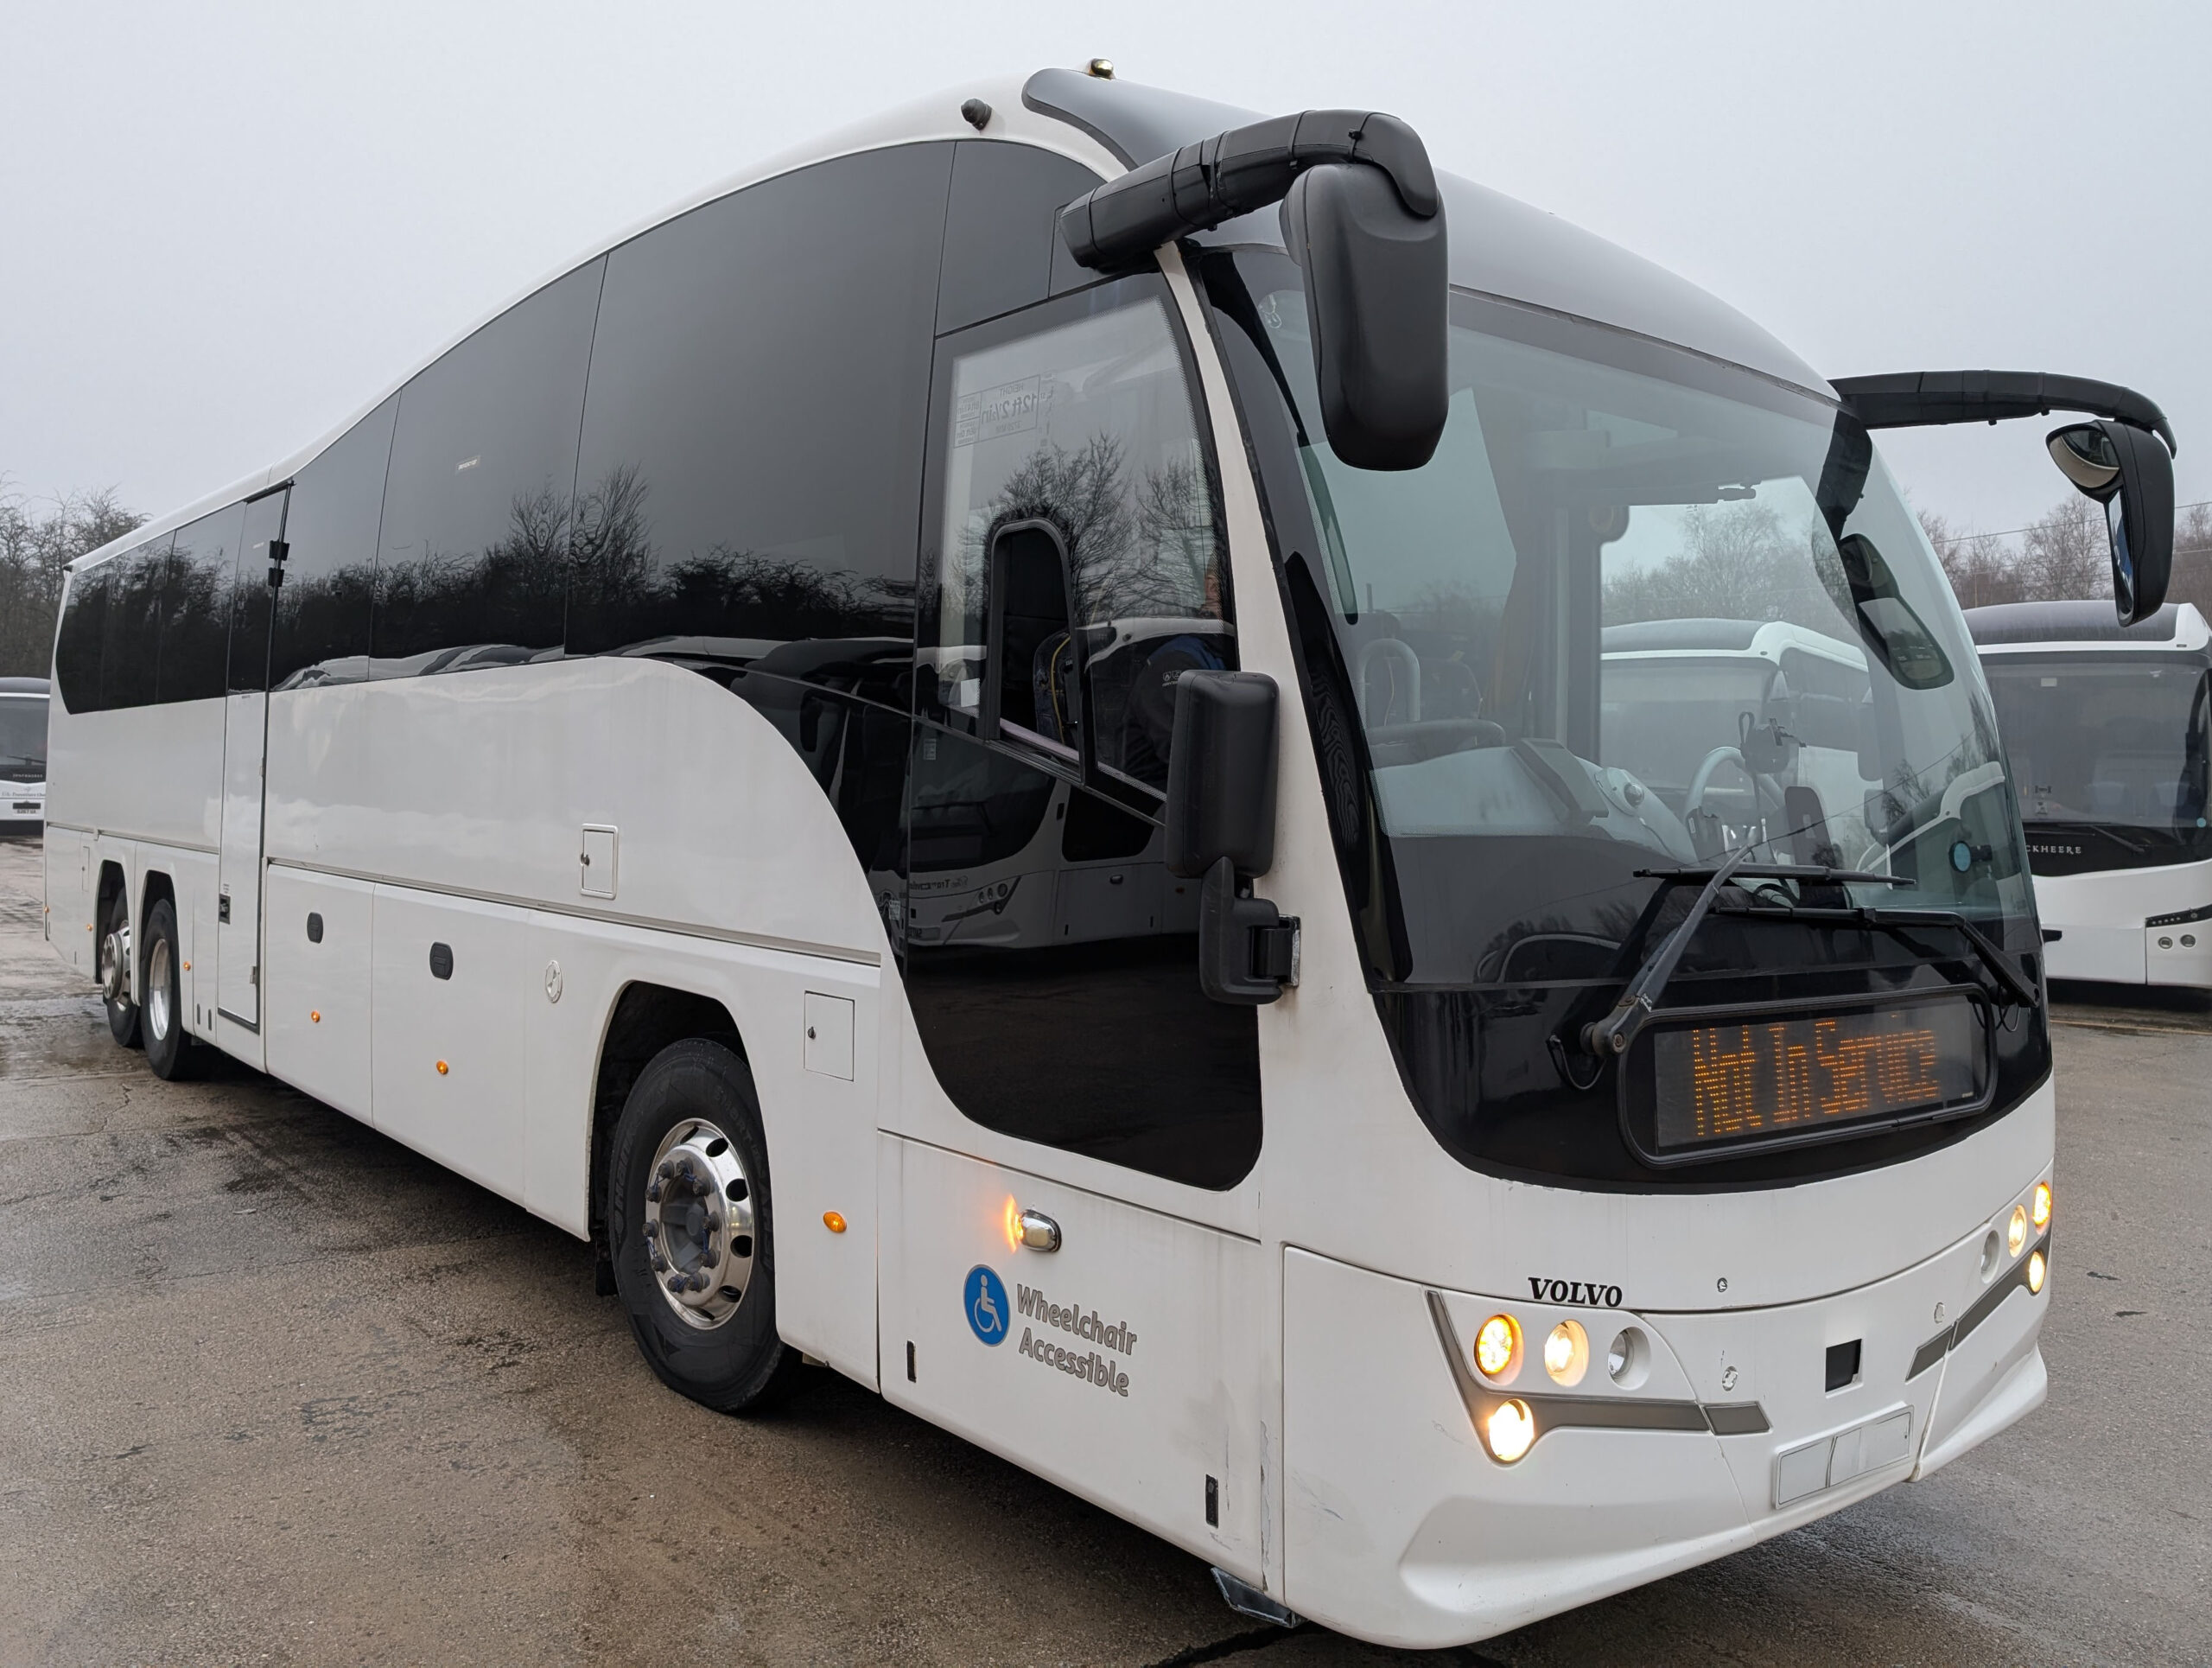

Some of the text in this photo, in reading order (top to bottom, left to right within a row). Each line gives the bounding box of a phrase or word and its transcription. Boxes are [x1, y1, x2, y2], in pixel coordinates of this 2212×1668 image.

[1017, 1283, 1137, 1355] Wheelchair
[1528, 1276, 1623, 1308] VOLVO
[1019, 1327, 1130, 1397] Accessible
